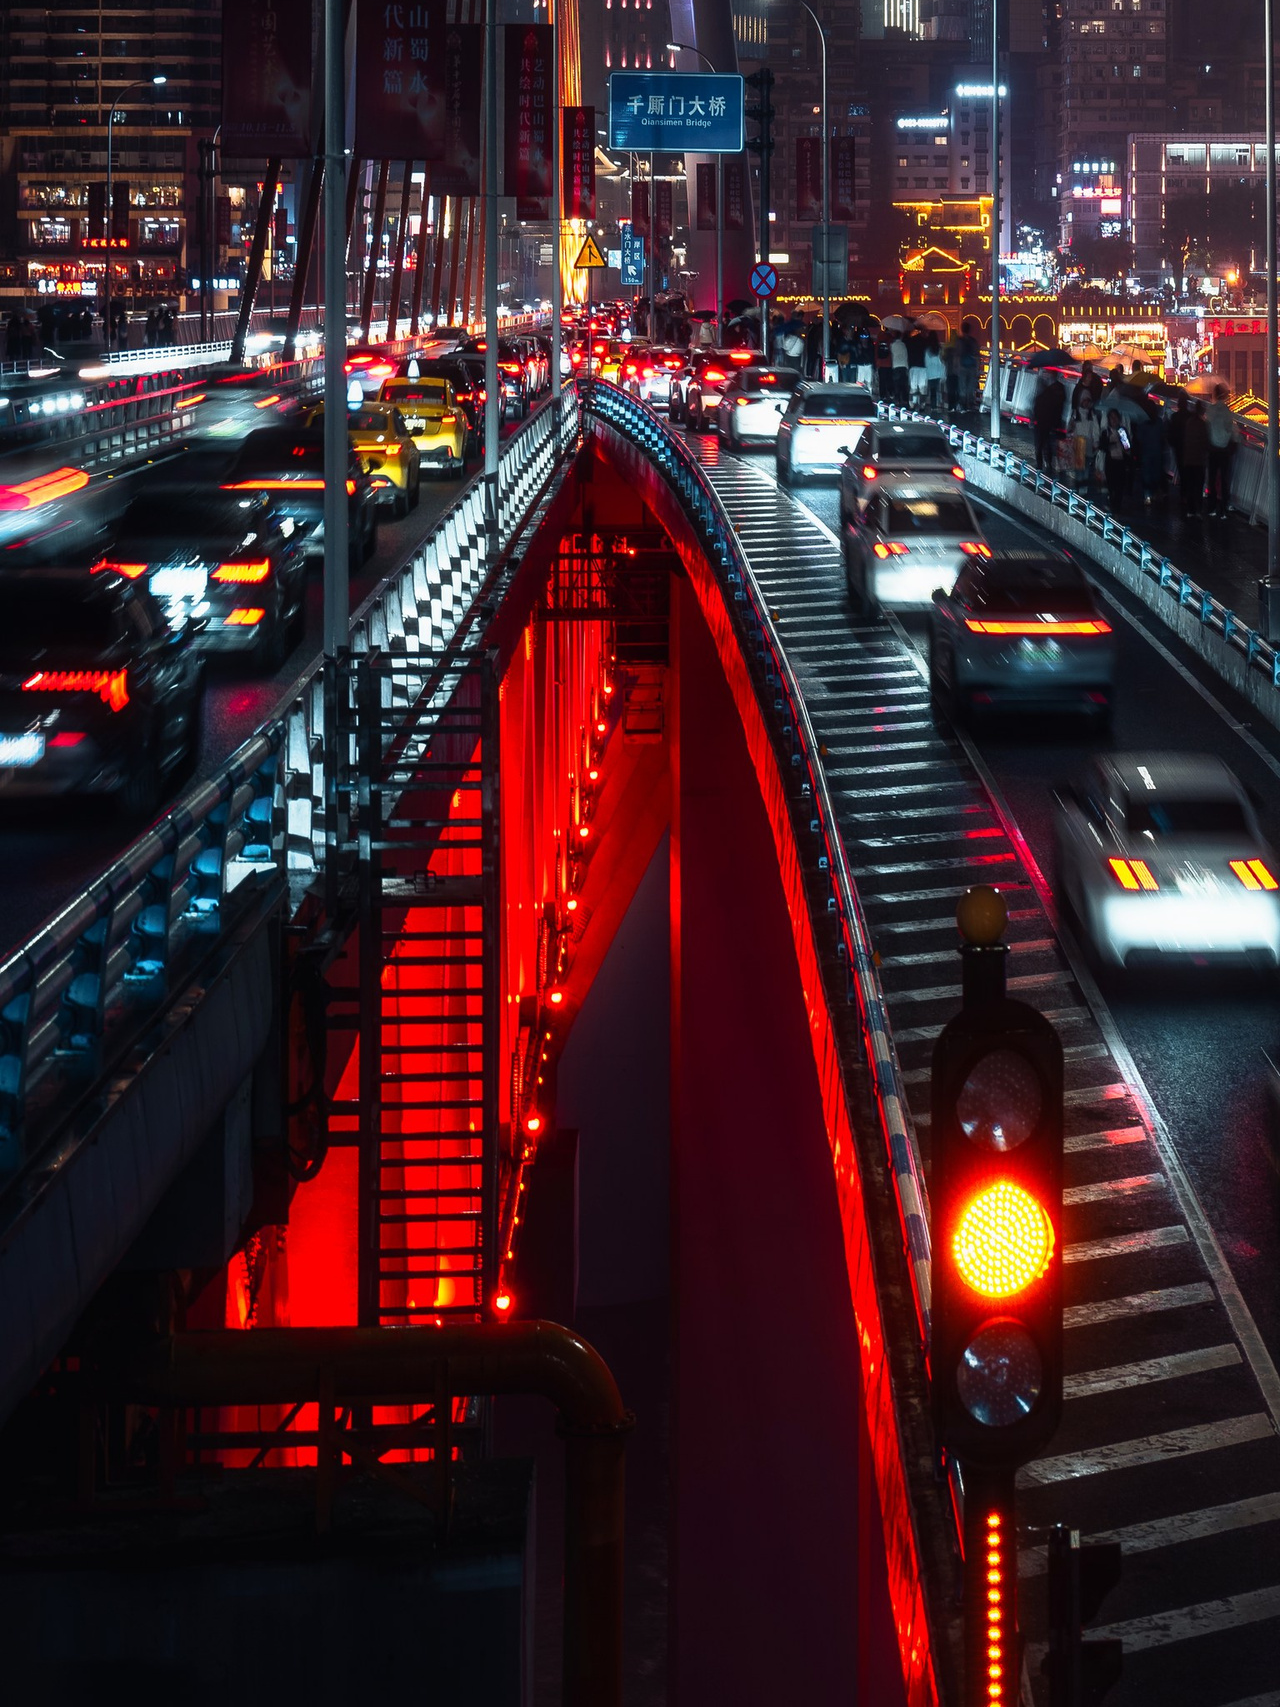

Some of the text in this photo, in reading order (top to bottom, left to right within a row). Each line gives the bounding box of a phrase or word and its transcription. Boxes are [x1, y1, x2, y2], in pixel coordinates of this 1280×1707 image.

[518, 58, 532, 162] 共绘时代新篇
[626, 95, 727, 117] 千厮门大桥
[641, 117, 712, 129] Qiansimen Bridge
[624, 224, 632, 265] 东水门大桥
